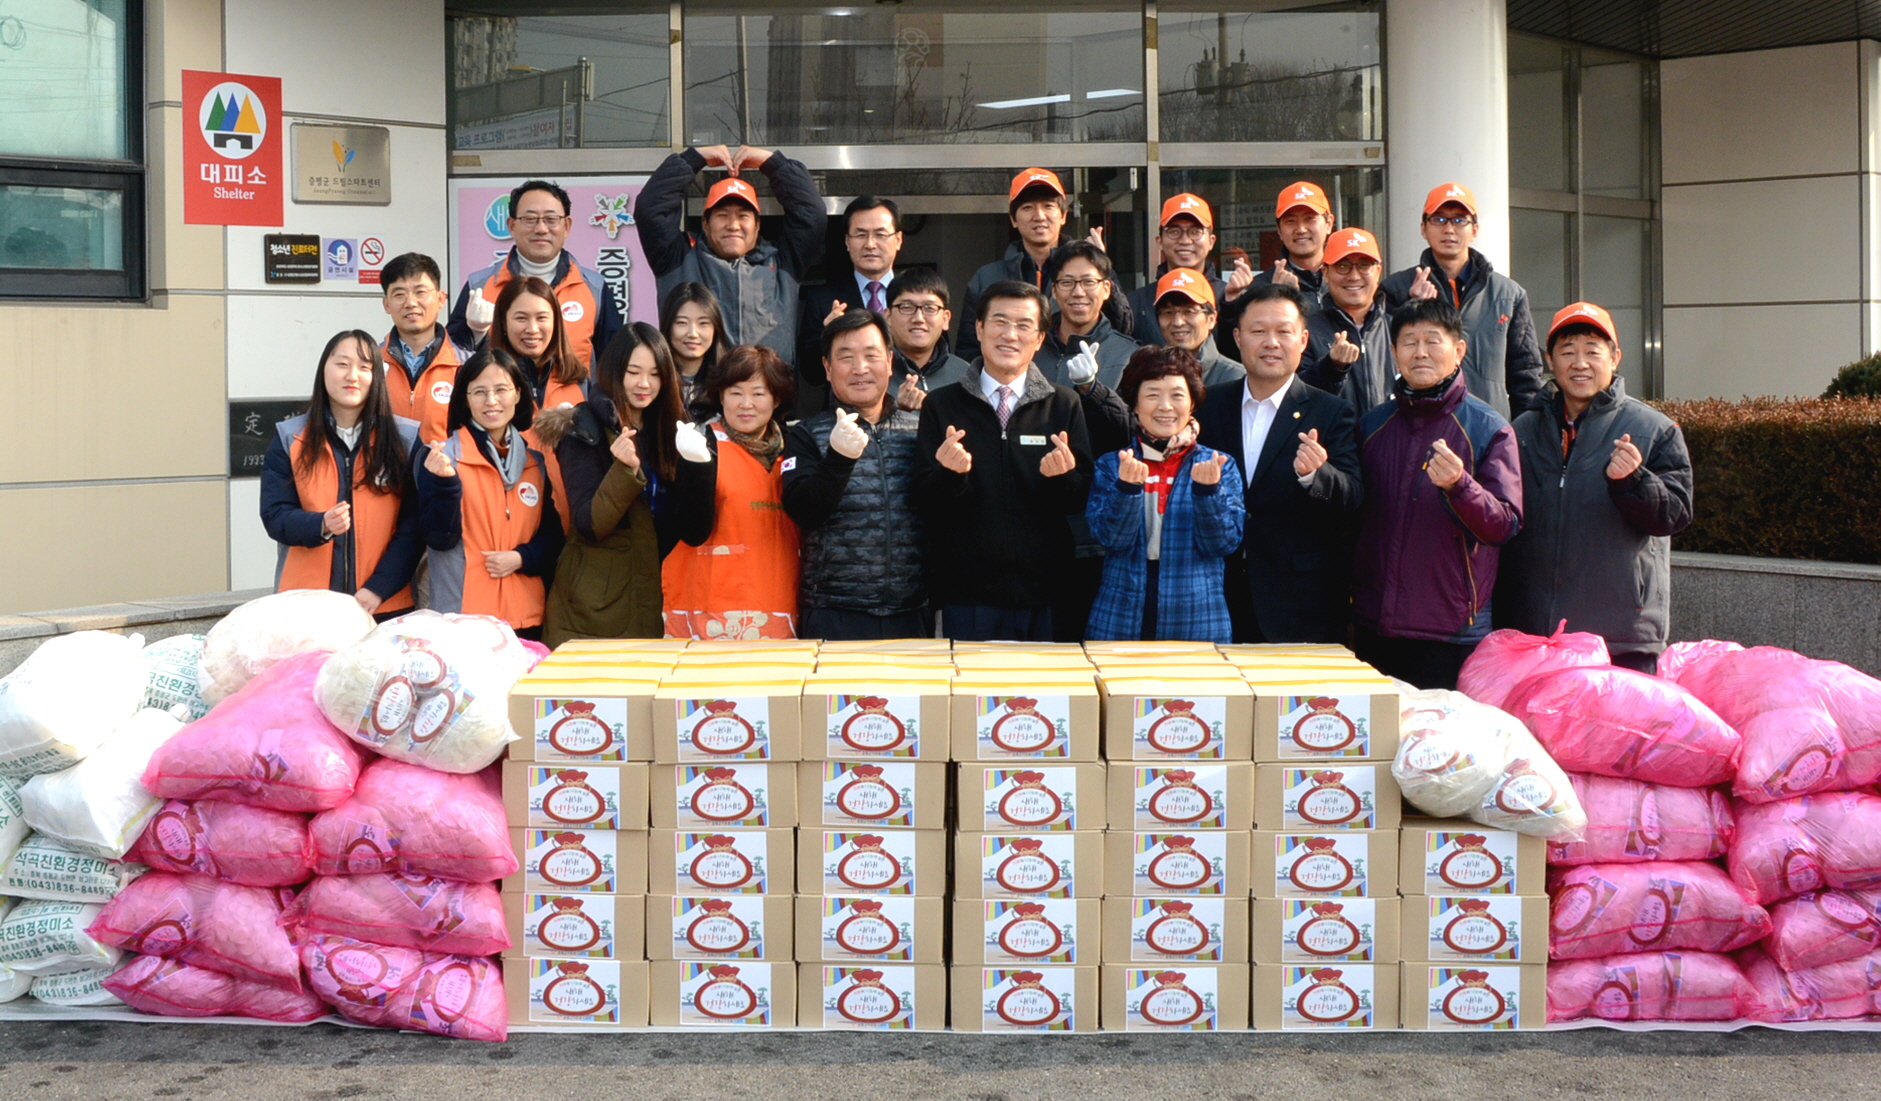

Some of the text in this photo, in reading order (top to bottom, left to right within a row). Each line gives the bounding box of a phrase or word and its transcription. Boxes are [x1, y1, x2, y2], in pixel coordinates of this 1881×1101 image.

[200, 163, 267, 185] 대피소
[309, 176, 381, 188] 증평군 드림스타트센터
[213, 187, 255, 200] Shelter
[1347, 239, 1360, 247] SK
[270, 244, 291, 255] 청소년
[1172, 279, 1185, 287] SK
[245, 411, 264, 436] 定
[15, 852, 120, 878] 석곡친환경정미소
